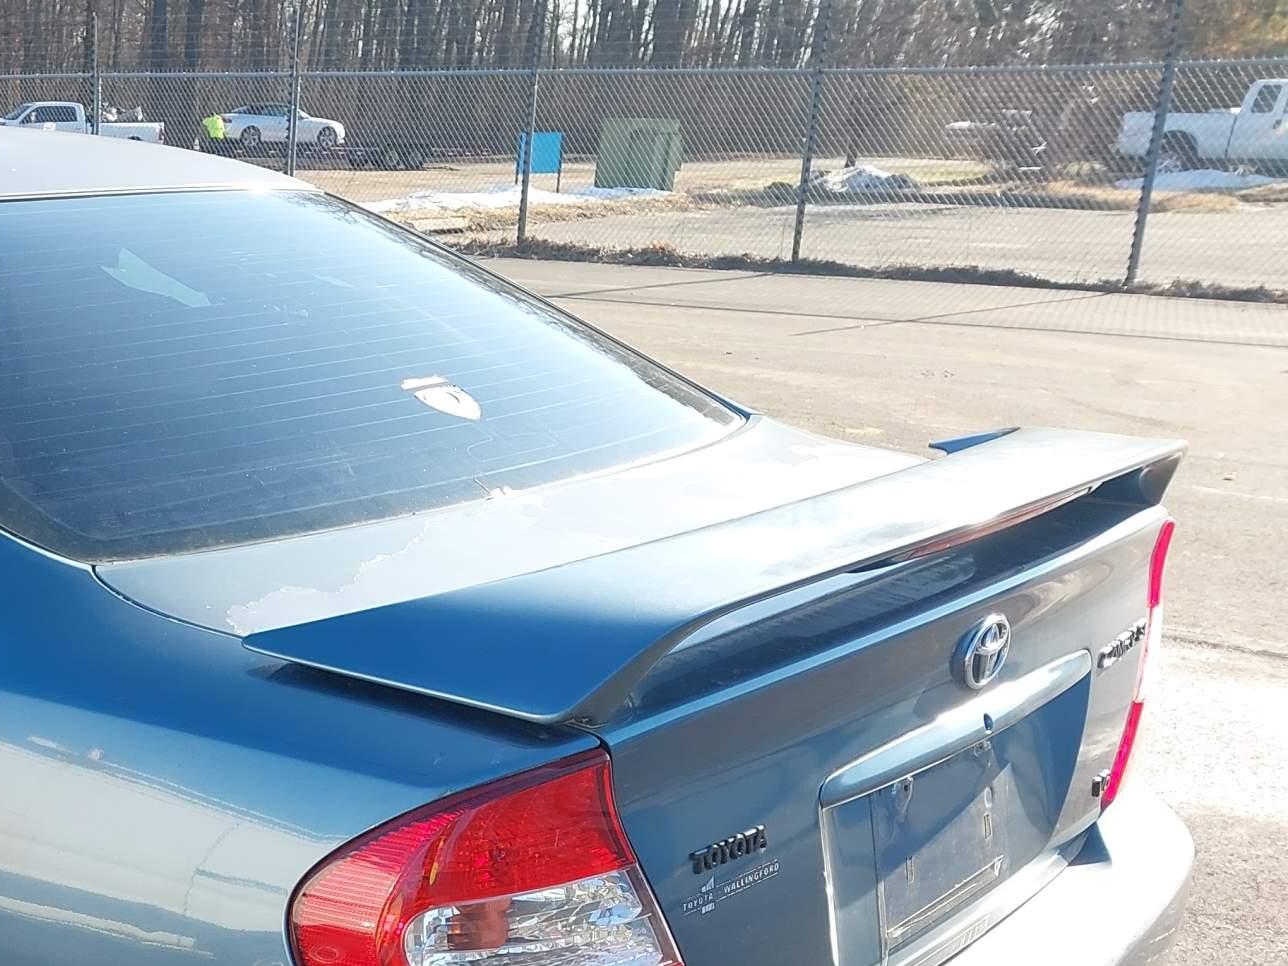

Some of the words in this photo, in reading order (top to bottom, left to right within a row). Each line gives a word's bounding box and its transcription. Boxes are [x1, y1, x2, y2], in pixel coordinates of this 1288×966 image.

[689, 824, 768, 875] TOYOTA
[682, 892, 714, 912] TOYOTA
[723, 862, 780, 894] WALLINGFORD
